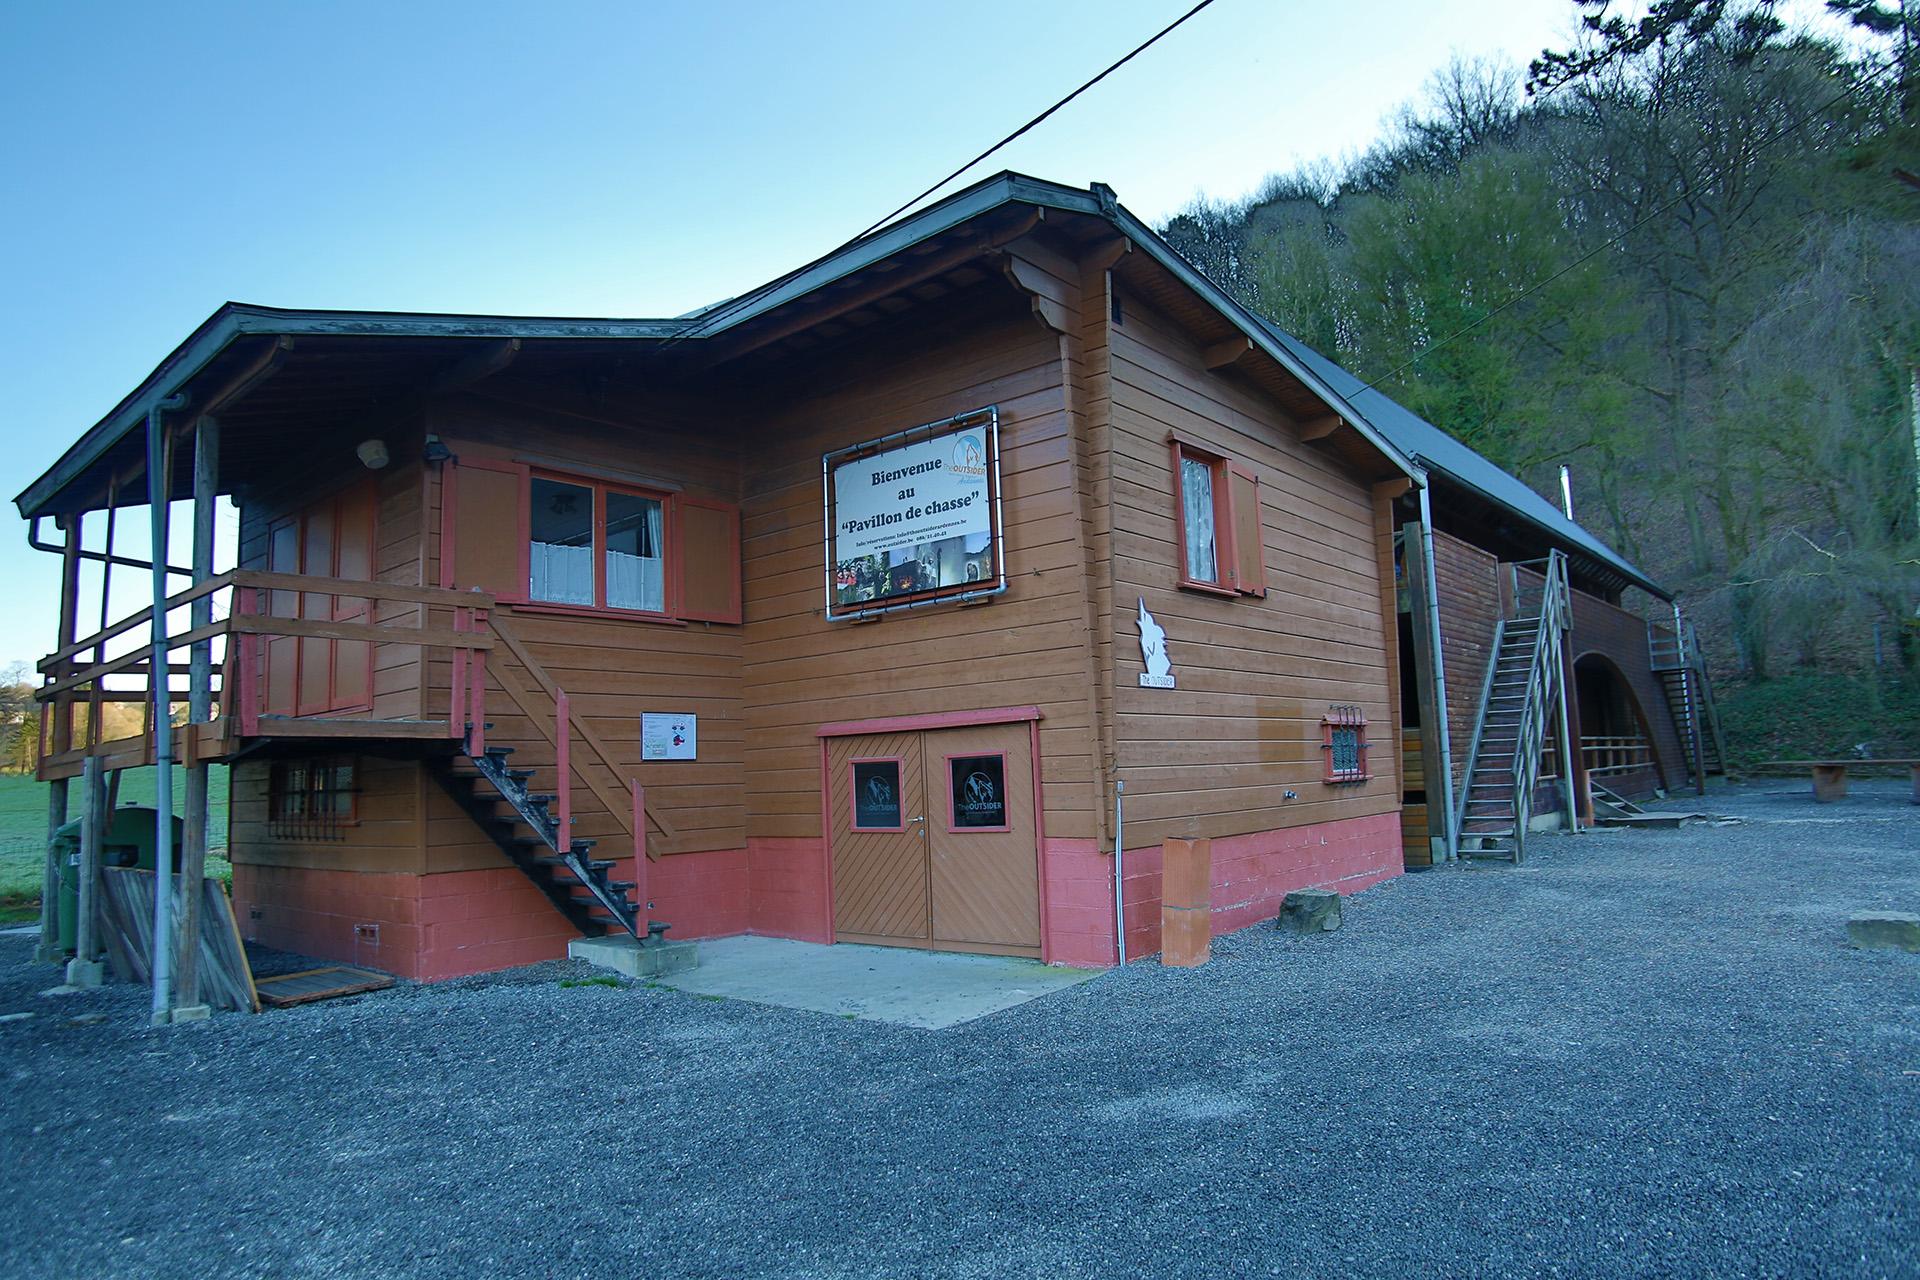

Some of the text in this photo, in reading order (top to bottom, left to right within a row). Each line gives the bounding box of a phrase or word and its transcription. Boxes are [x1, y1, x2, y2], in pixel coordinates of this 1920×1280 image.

[871, 458, 942, 486] Bienvenue
[897, 486, 915, 501] au
[841, 490, 980, 534] “Pavillon de chasse”
[1141, 674, 1173, 686] The OUTSIDER
